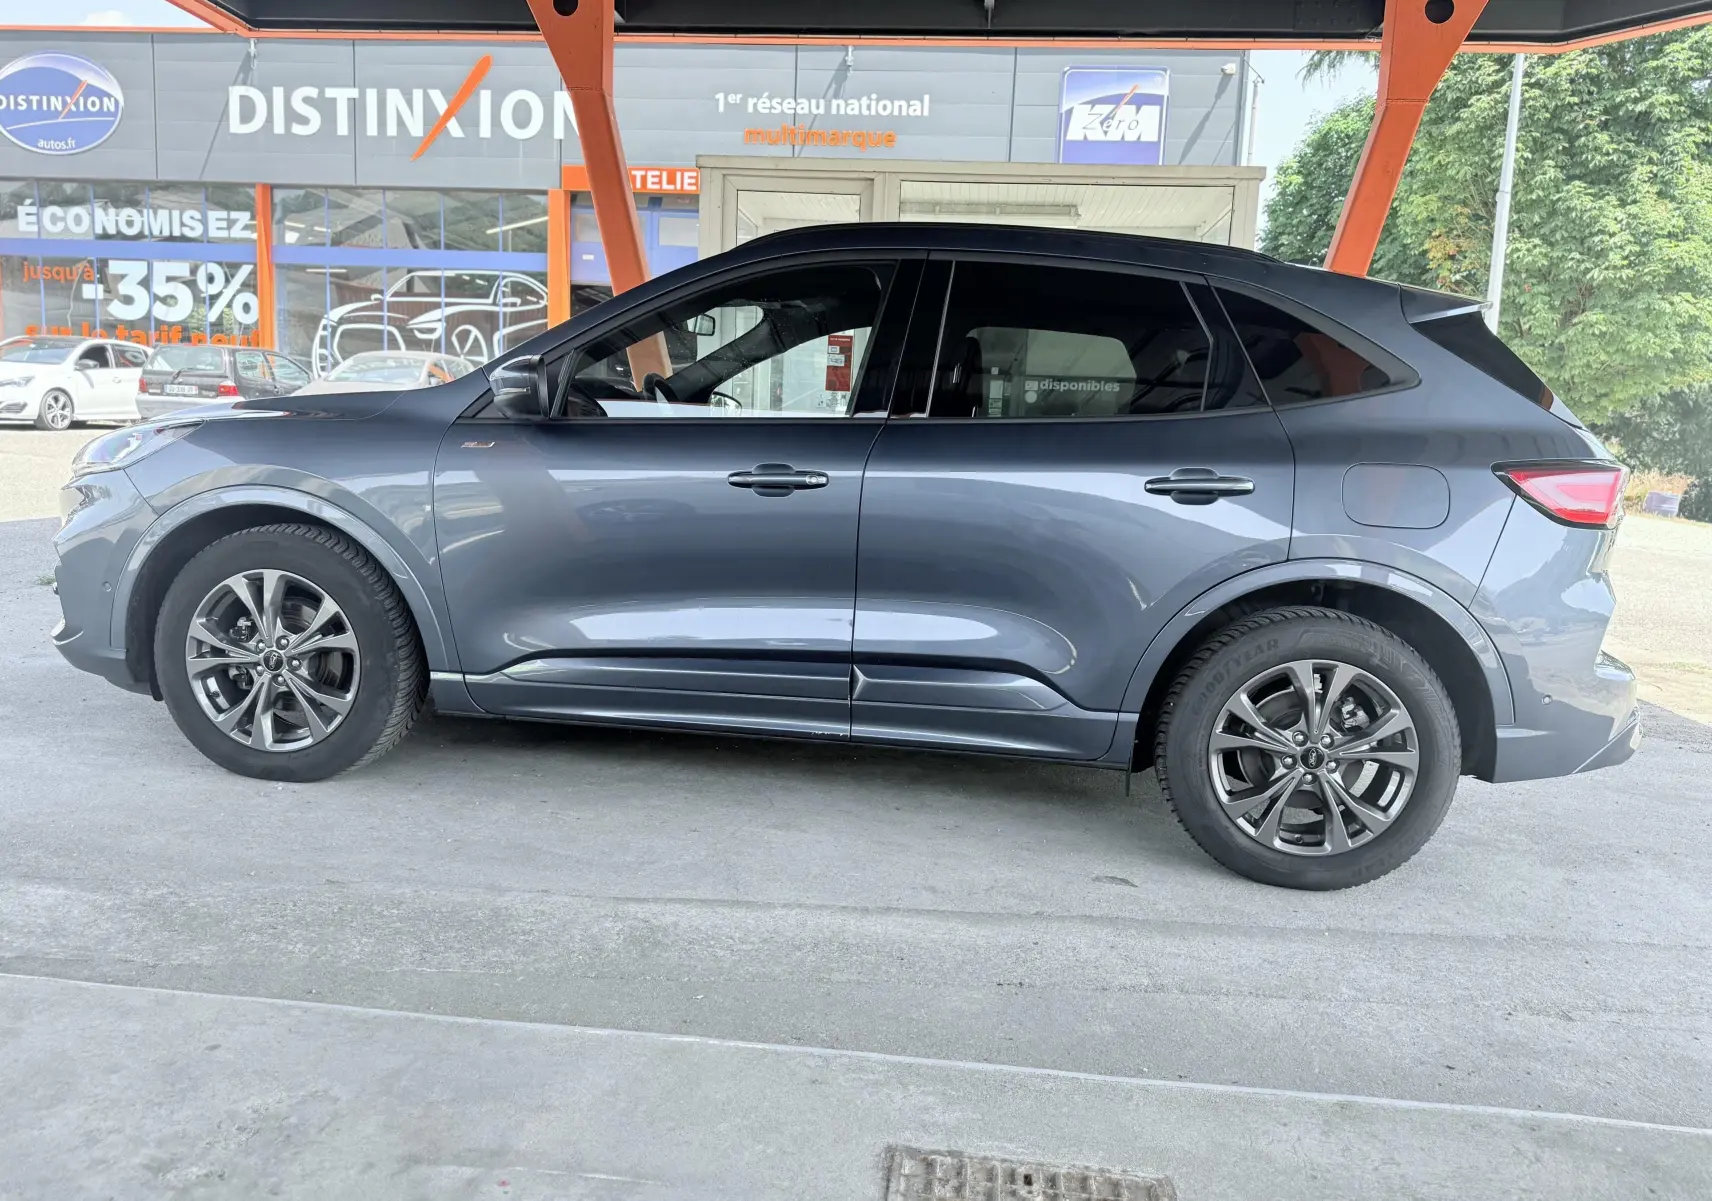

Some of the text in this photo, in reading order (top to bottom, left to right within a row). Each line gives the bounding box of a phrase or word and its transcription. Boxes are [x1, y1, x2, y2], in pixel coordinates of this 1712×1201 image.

[747, 93, 825, 115] réseau
[831, 94, 930, 117] national
[37, 137, 76, 150] autos.fr
[743, 123, 897, 152] multimarque
[631, 170, 697, 191] TELIE
[17, 199, 253, 239] ÉCONOMISEZ
[116, 324, 182, 347] tarif
[1039, 379, 1121, 392] disponibles
